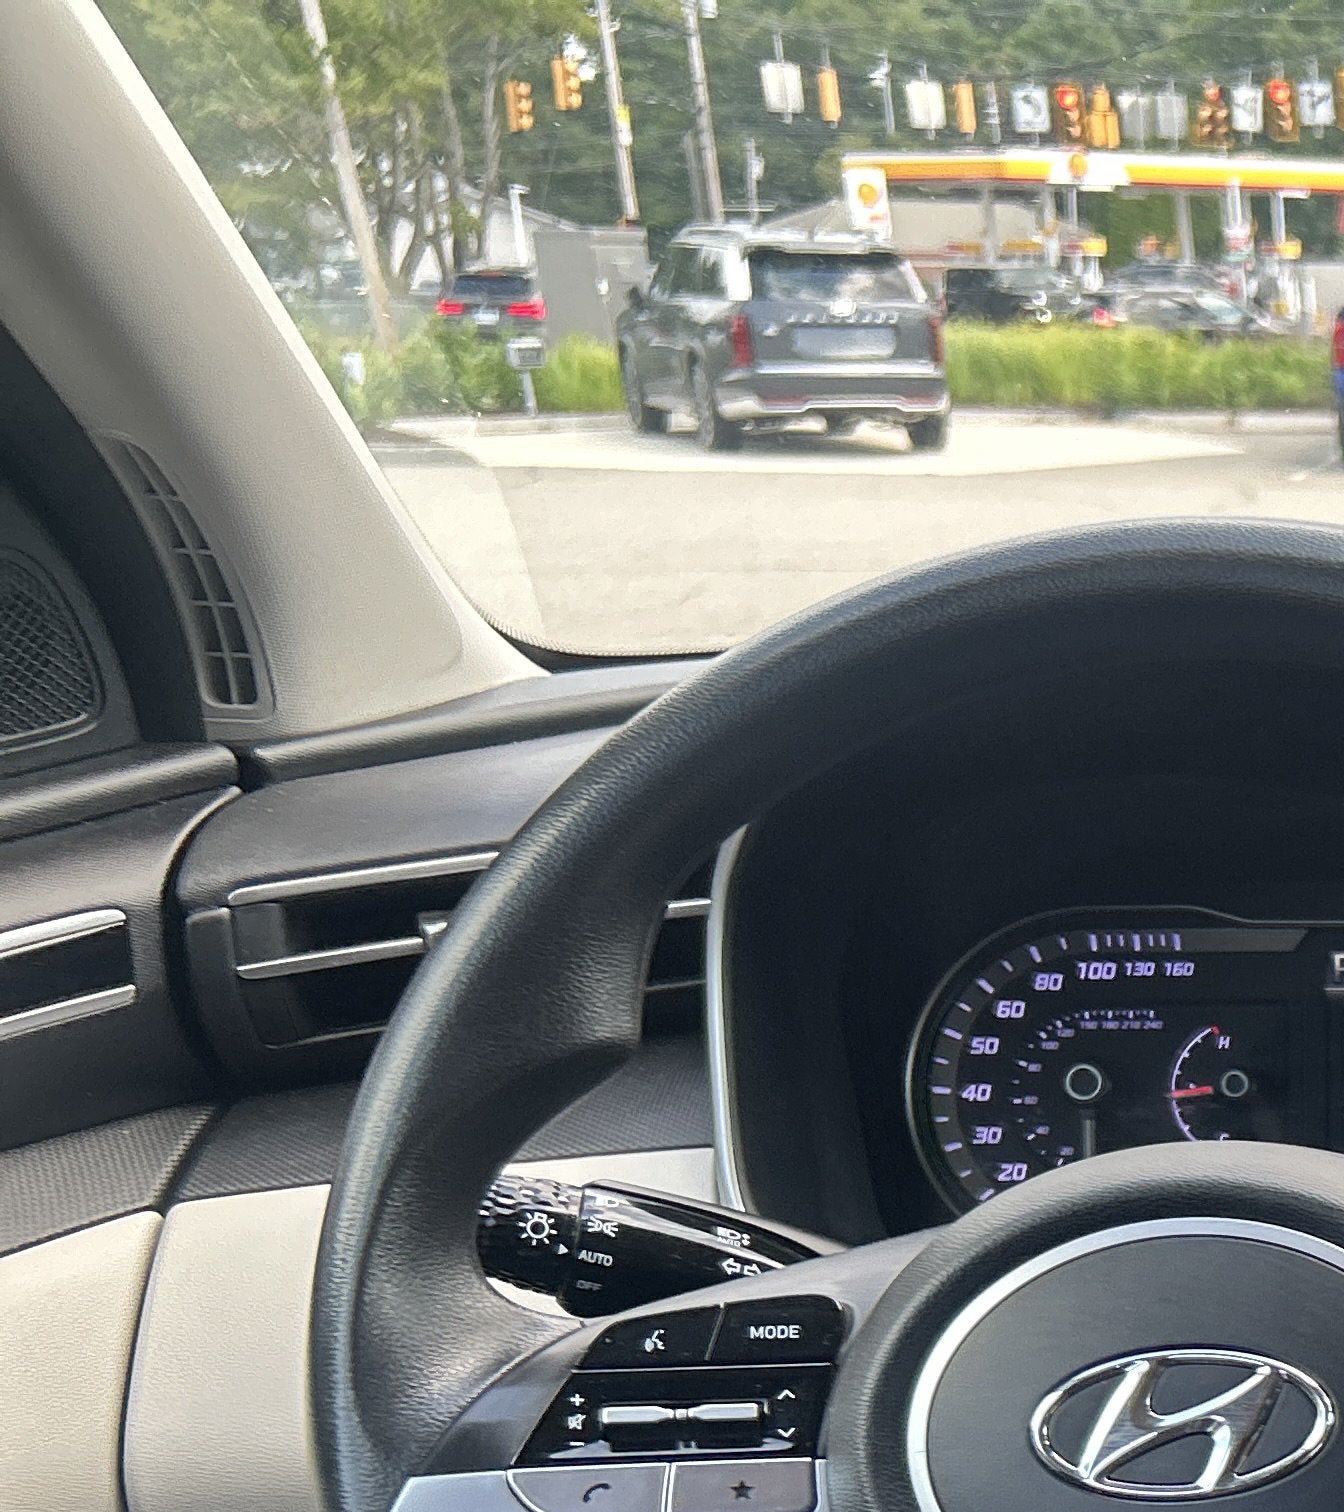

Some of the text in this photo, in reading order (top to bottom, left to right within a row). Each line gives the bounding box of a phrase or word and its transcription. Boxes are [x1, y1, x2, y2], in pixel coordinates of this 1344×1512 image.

[1077, 962, 1195, 980] 100 130 160
[1033, 973, 1063, 991] 80
[995, 1001, 1025, 1018] 60
[970, 1037, 999, 1054] 50
[1218, 1036, 1232, 1049] H
[961, 1083, 992, 1101] 40
[972, 1126, 1002, 1144] 30
[997, 1163, 1027, 1181] 20
[578, 1249, 613, 1267] AUTO
[749, 1324, 800, 1340] MODE
